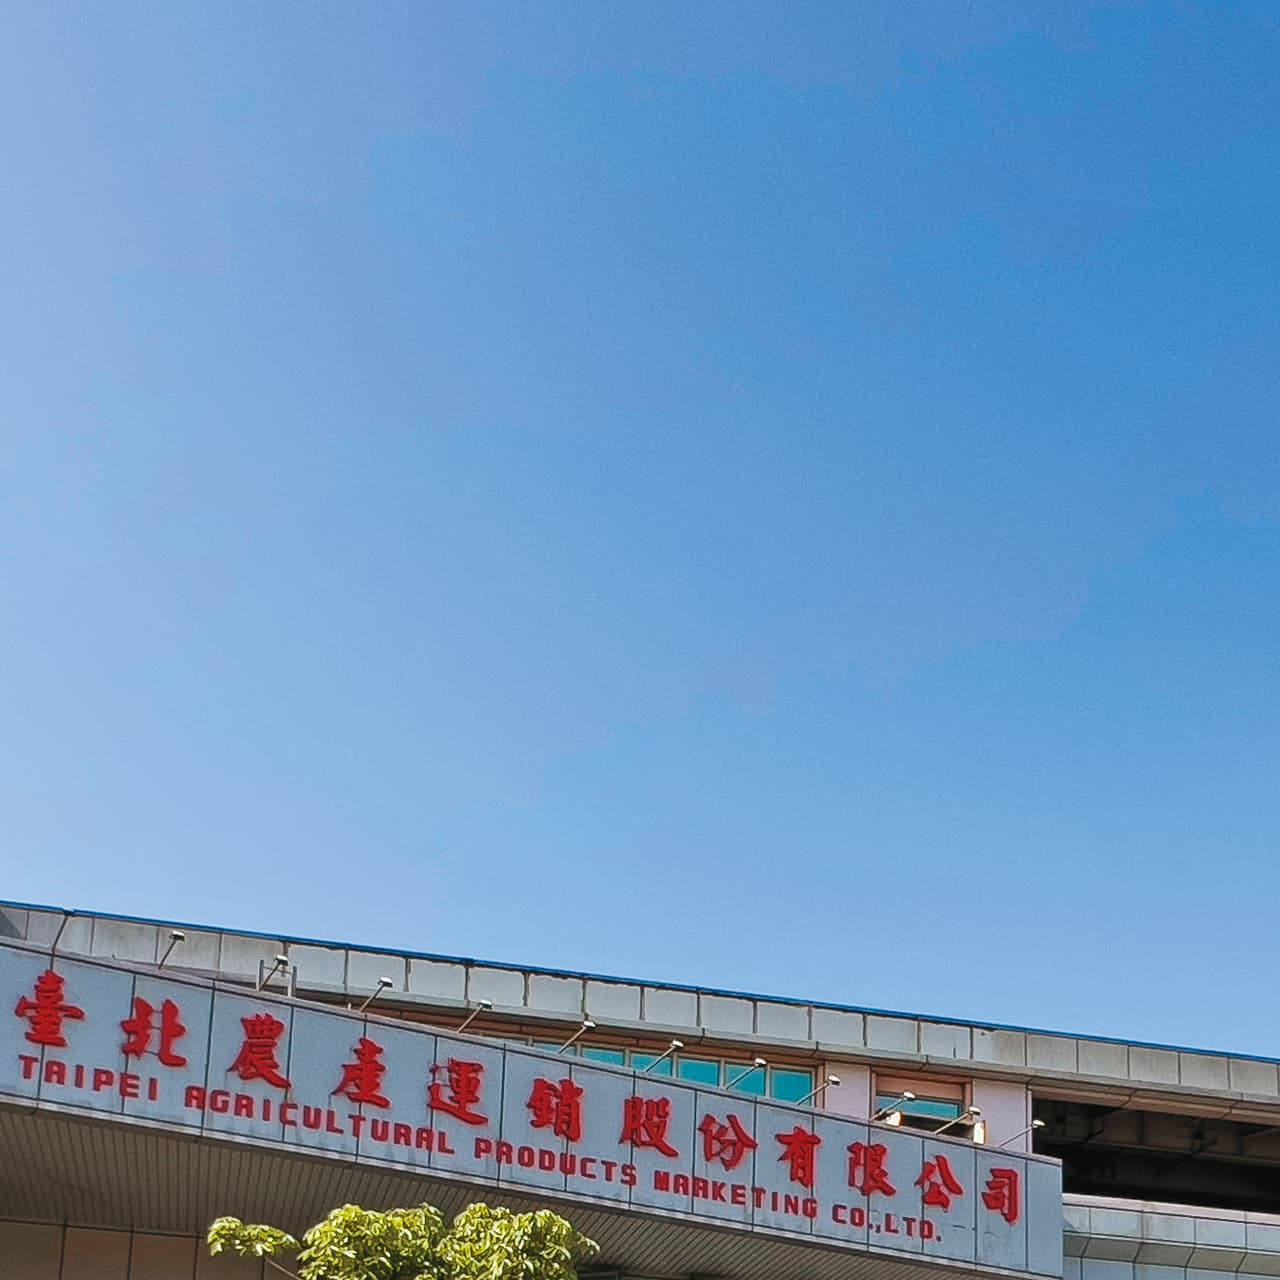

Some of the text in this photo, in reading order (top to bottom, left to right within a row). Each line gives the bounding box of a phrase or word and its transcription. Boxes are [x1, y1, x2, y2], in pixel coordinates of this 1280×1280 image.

[14, 970, 1020, 1225] 臺北農產運銷股份有限公司
[19, 1055, 158, 1102] TAIPEI
[184, 1085, 454, 1155] AGRICULTURAL
[474, 1137, 638, 1187] PRODUCTS
[653, 1170, 818, 1221] MARKETING
